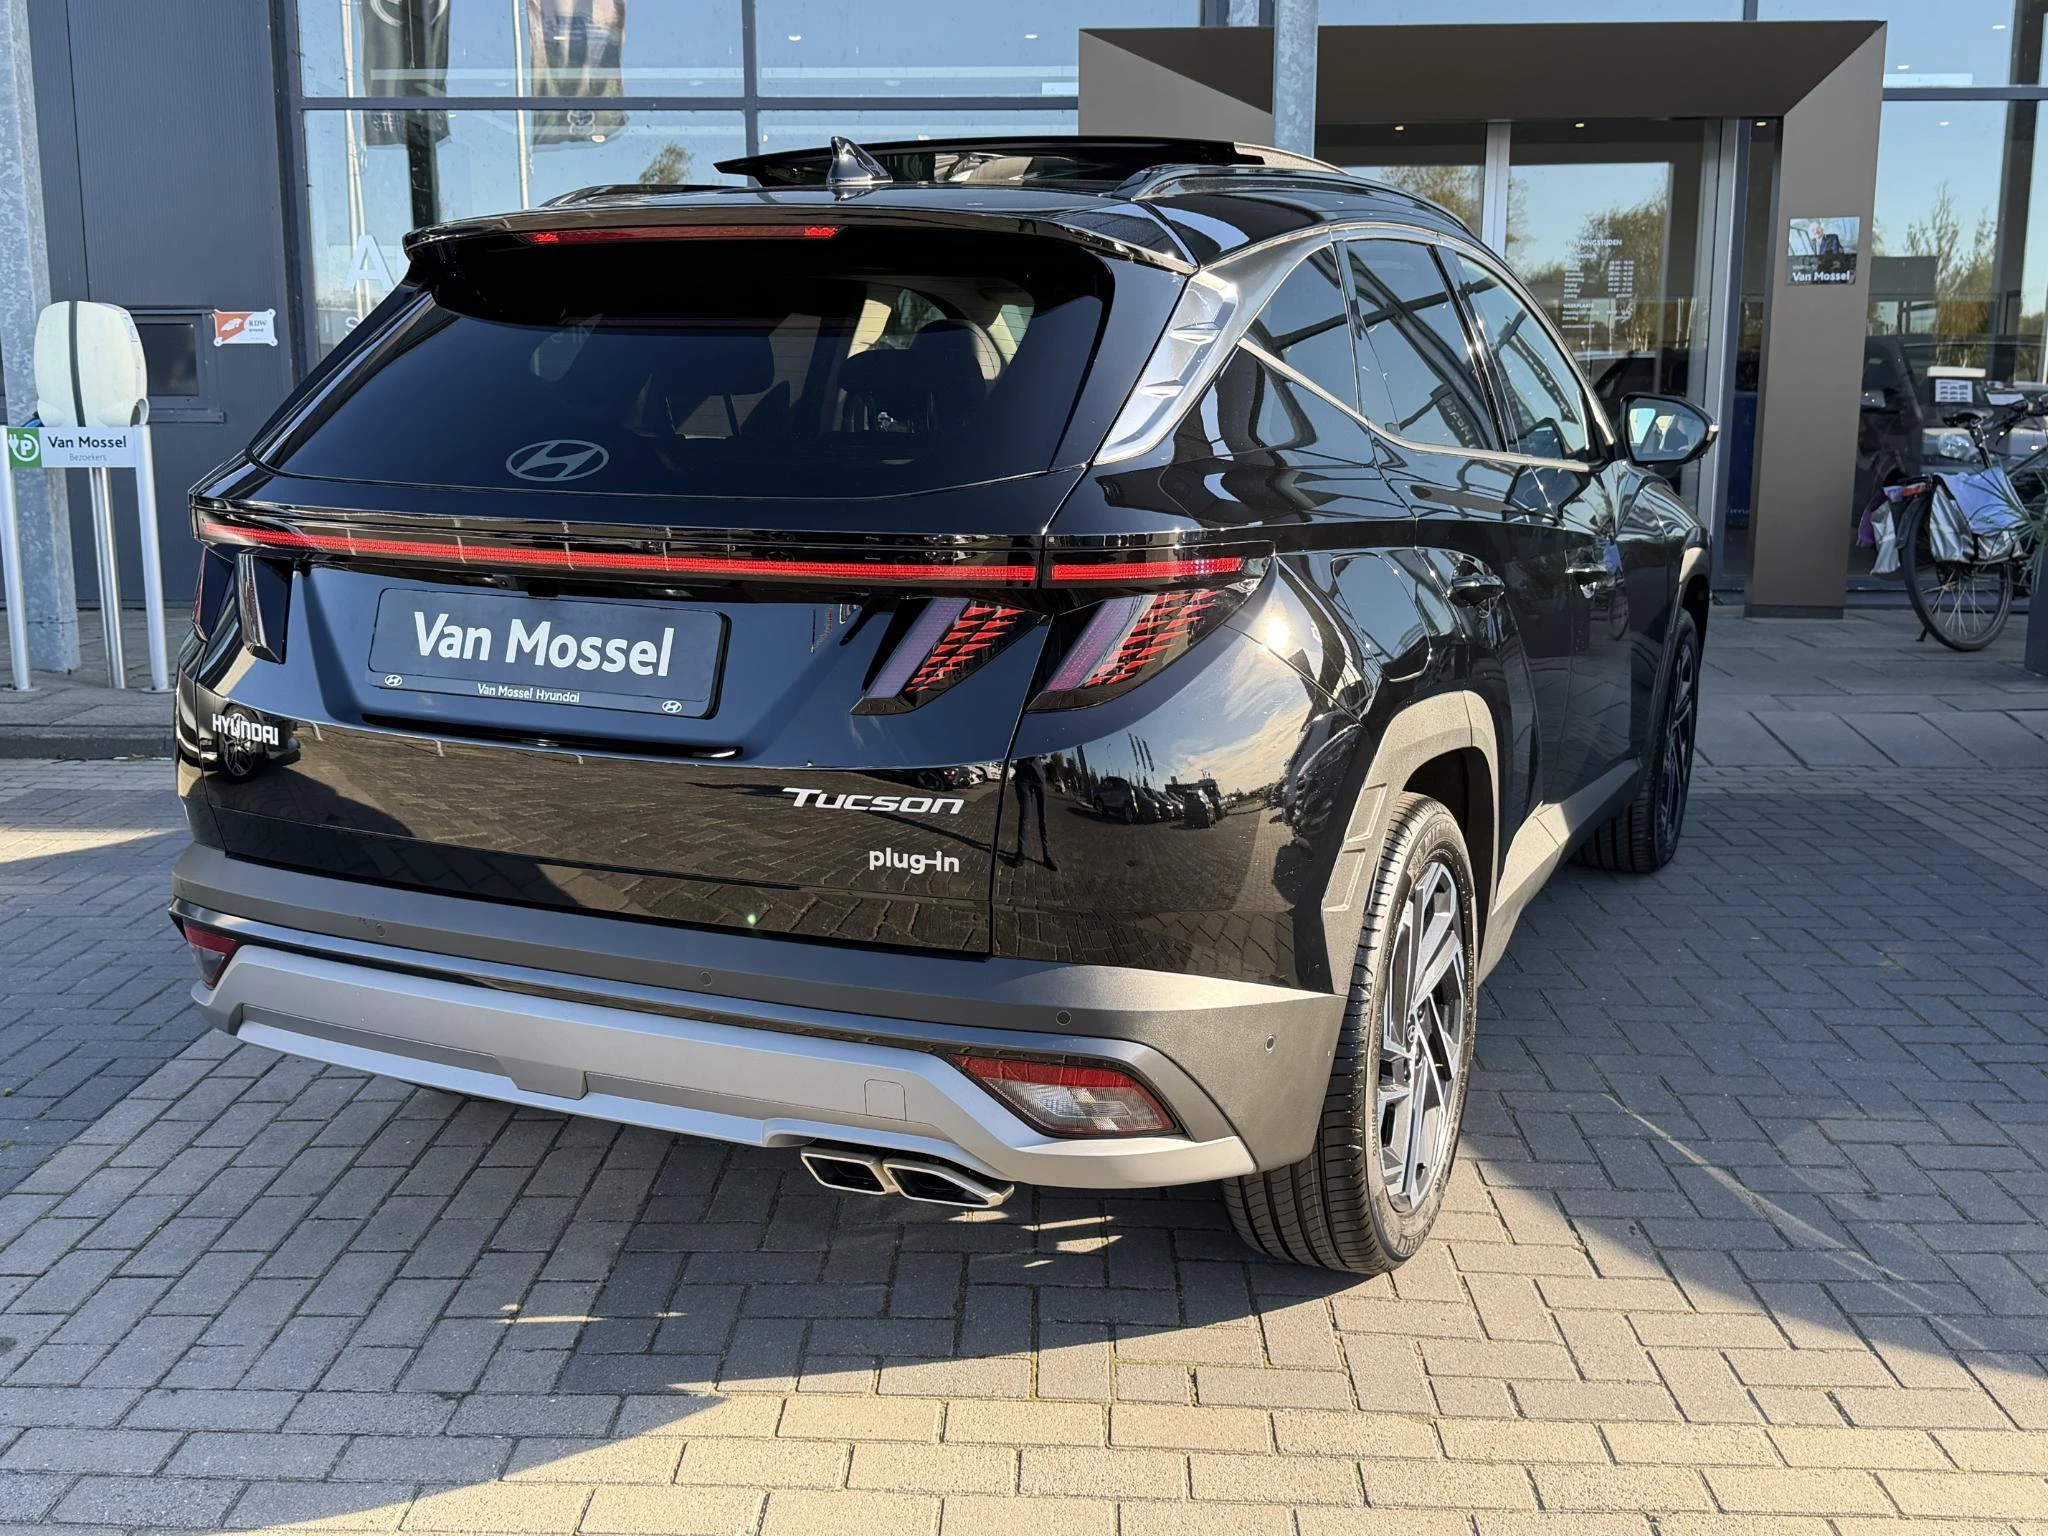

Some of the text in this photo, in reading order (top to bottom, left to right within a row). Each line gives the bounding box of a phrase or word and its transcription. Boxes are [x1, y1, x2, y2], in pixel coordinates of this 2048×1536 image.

[1792, 270, 1851, 281] Van Mossel
[48, 435, 127, 449] Van Mossel
[69, 453, 108, 462] Bezoekers
[414, 611, 675, 677] Van Mossel
[477, 683, 580, 704] Van Mossel Hyundai
[212, 713, 279, 746] HYUNDAI
[869, 847, 960, 875] plug-in
